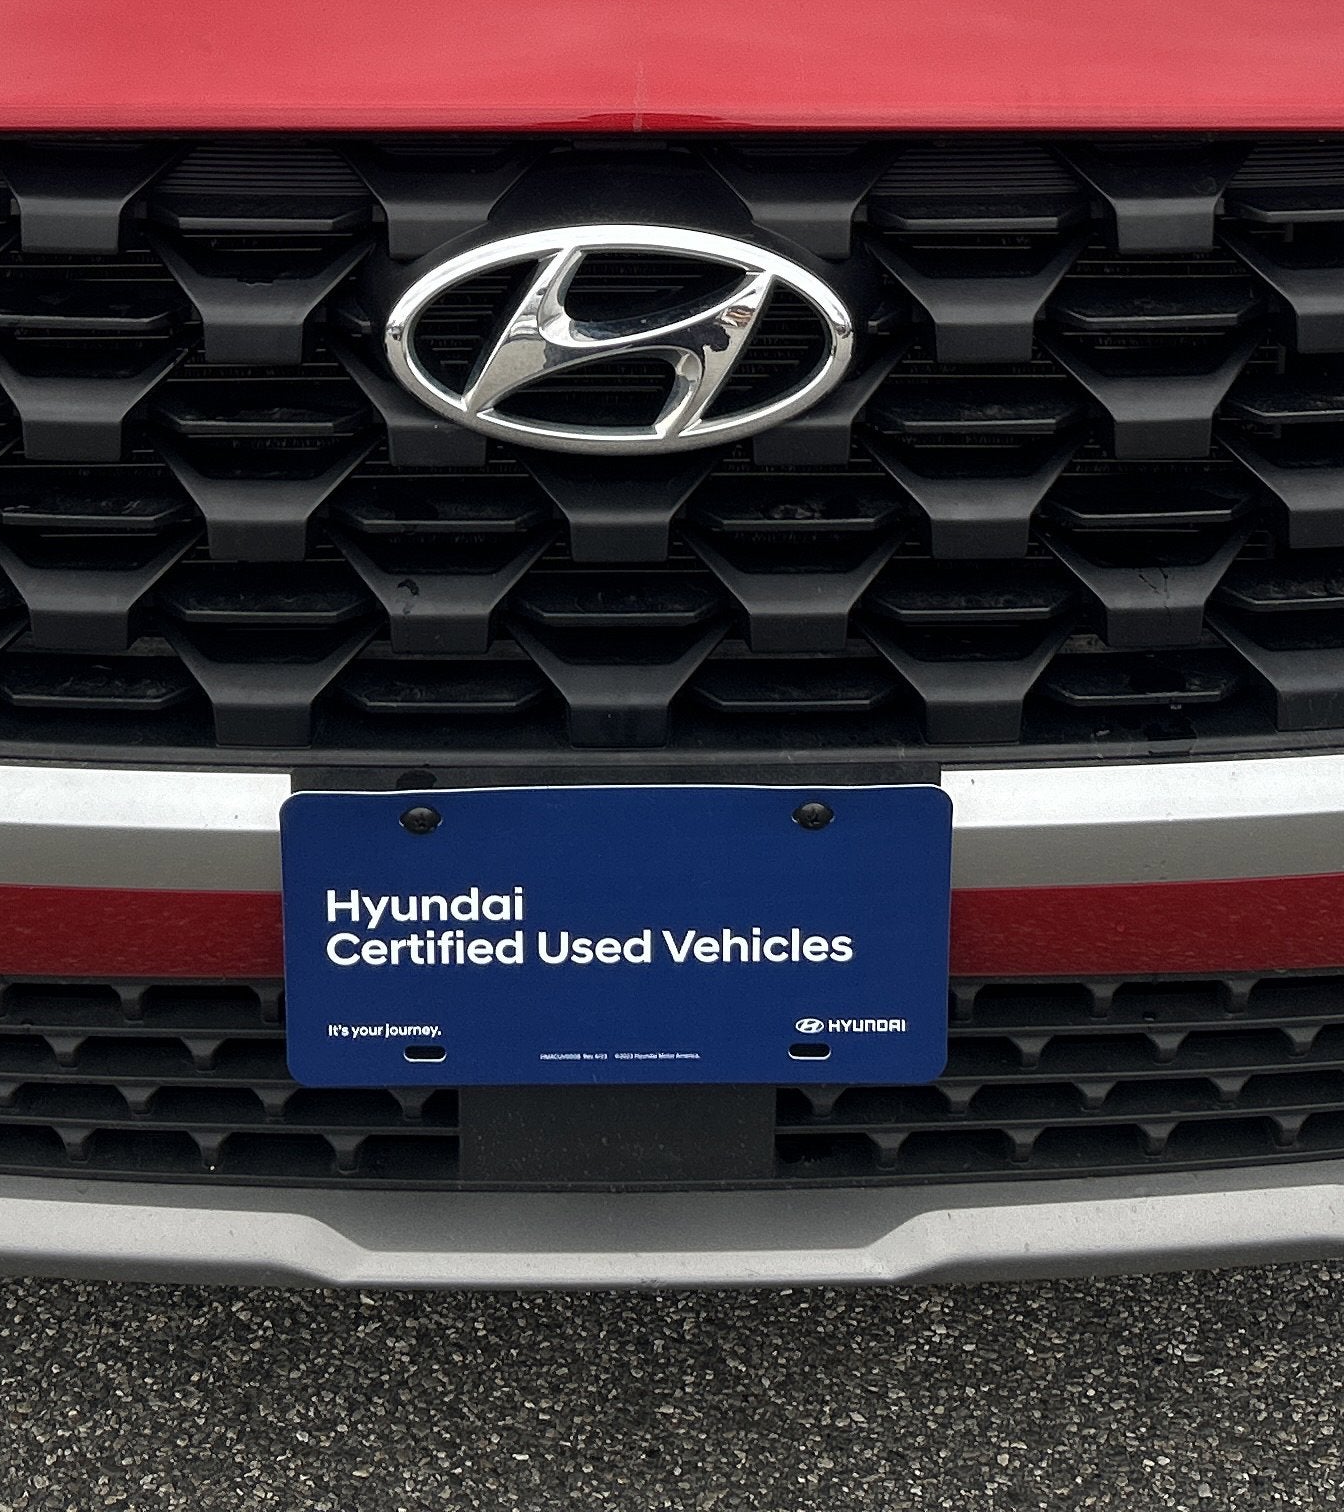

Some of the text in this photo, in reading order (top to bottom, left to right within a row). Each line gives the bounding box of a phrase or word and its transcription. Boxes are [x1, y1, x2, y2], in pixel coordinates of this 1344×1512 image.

[326, 887, 523, 928] Hyundai
[326, 927, 853, 966] Certified Used Vehicles
[328, 1023, 442, 1038] It's your journey.
[828, 1019, 906, 1032] HYUNDAI
